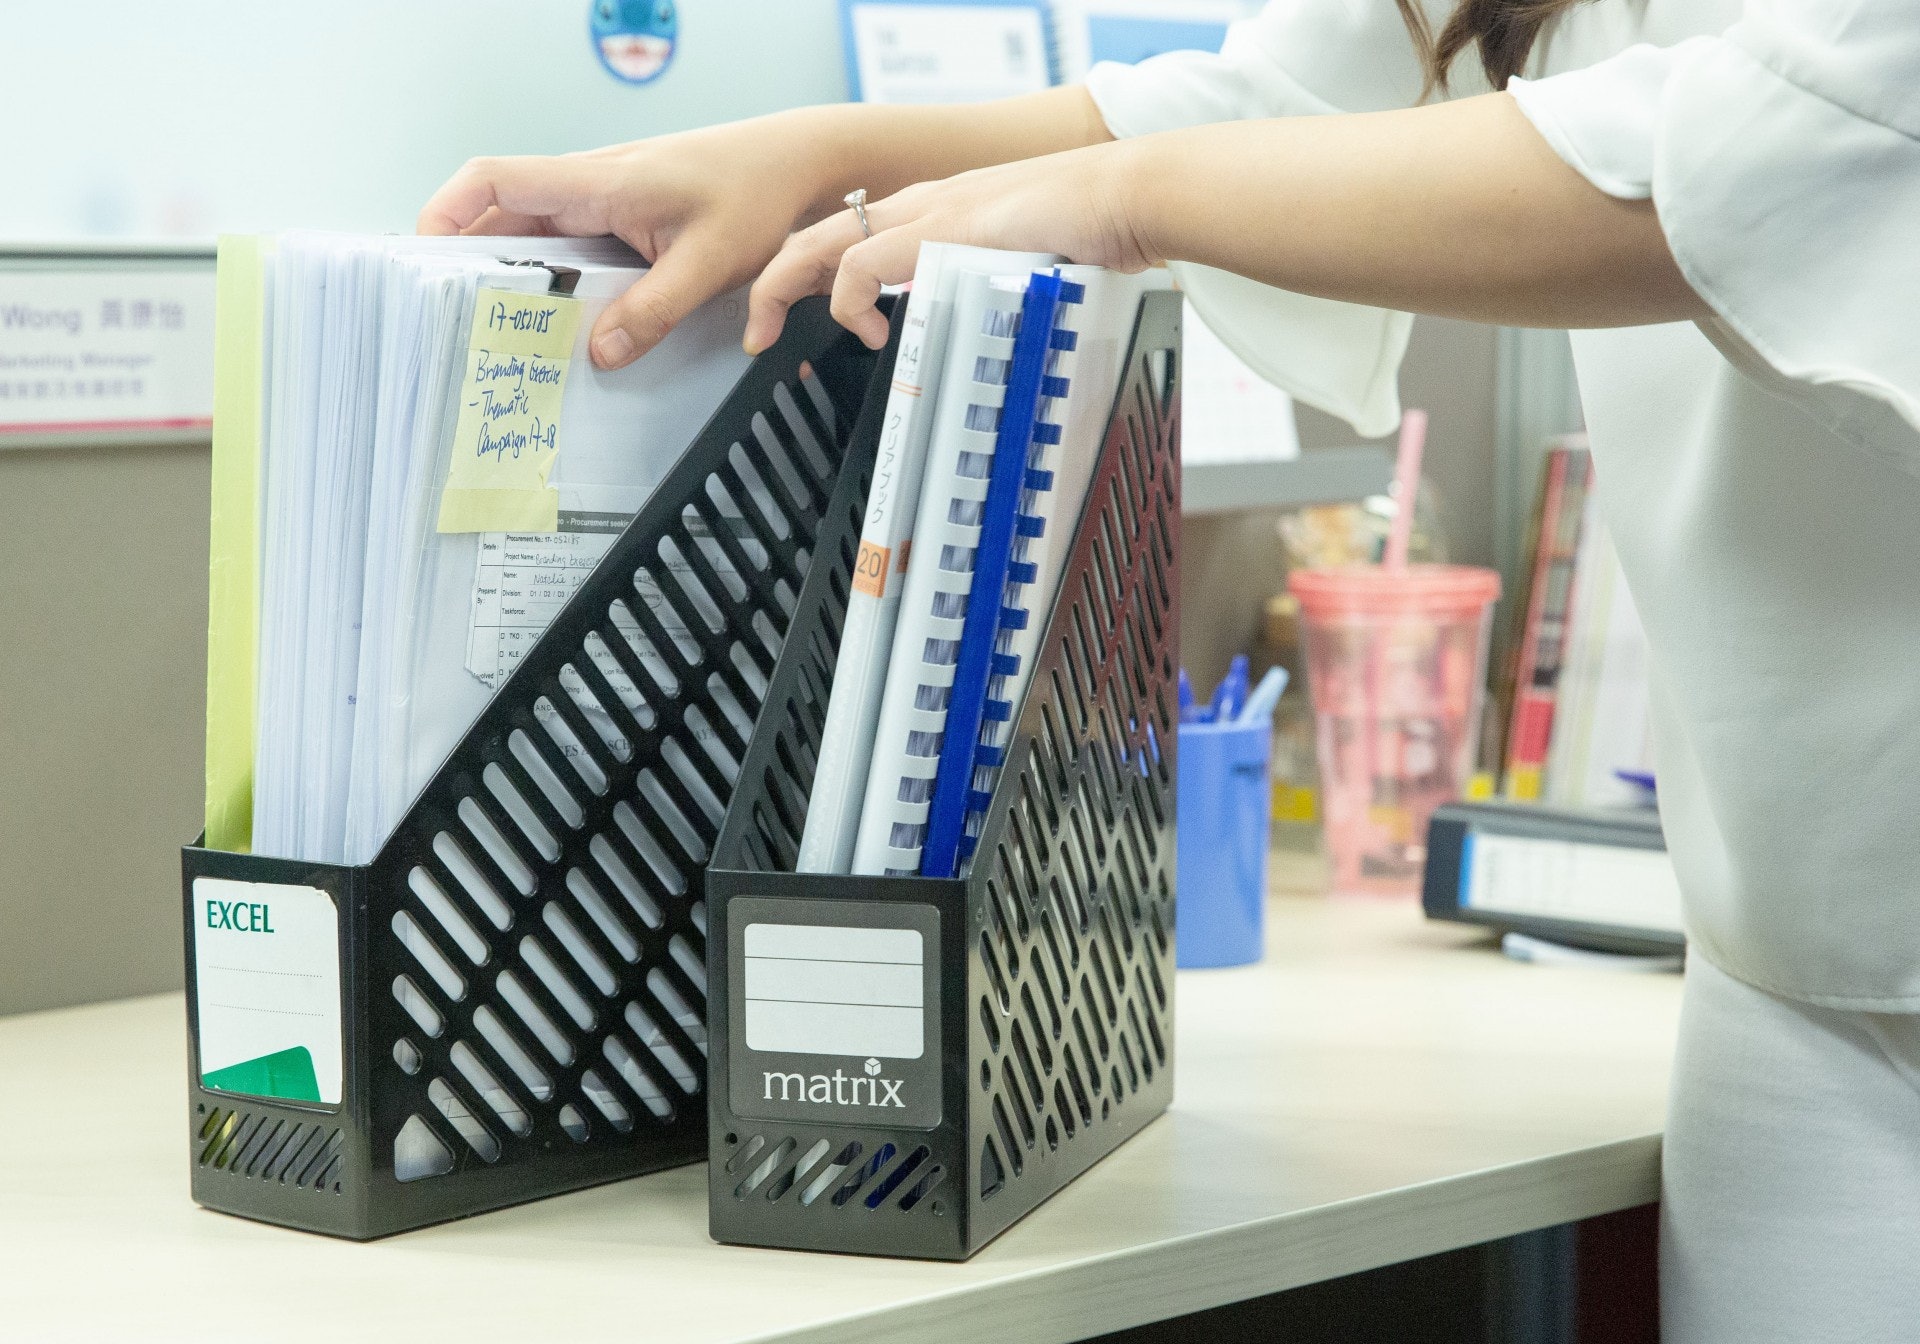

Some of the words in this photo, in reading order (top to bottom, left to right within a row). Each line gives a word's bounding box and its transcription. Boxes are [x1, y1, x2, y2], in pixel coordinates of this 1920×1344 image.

[902, 344, 919, 364] A4
[475, 349, 526, 393] Branding
[482, 389, 530, 421] Thematic
[476, 422, 527, 462] Campaign
[506, 534, 534, 542] Procurement
[570, 518, 609, 527] Procurement
[504, 553, 519, 561] Project
[857, 547, 882, 578] 20
[477, 587, 497, 595] Prepared
[206, 899, 275, 933] EXCEL
[762, 1060, 907, 1108] matrix
